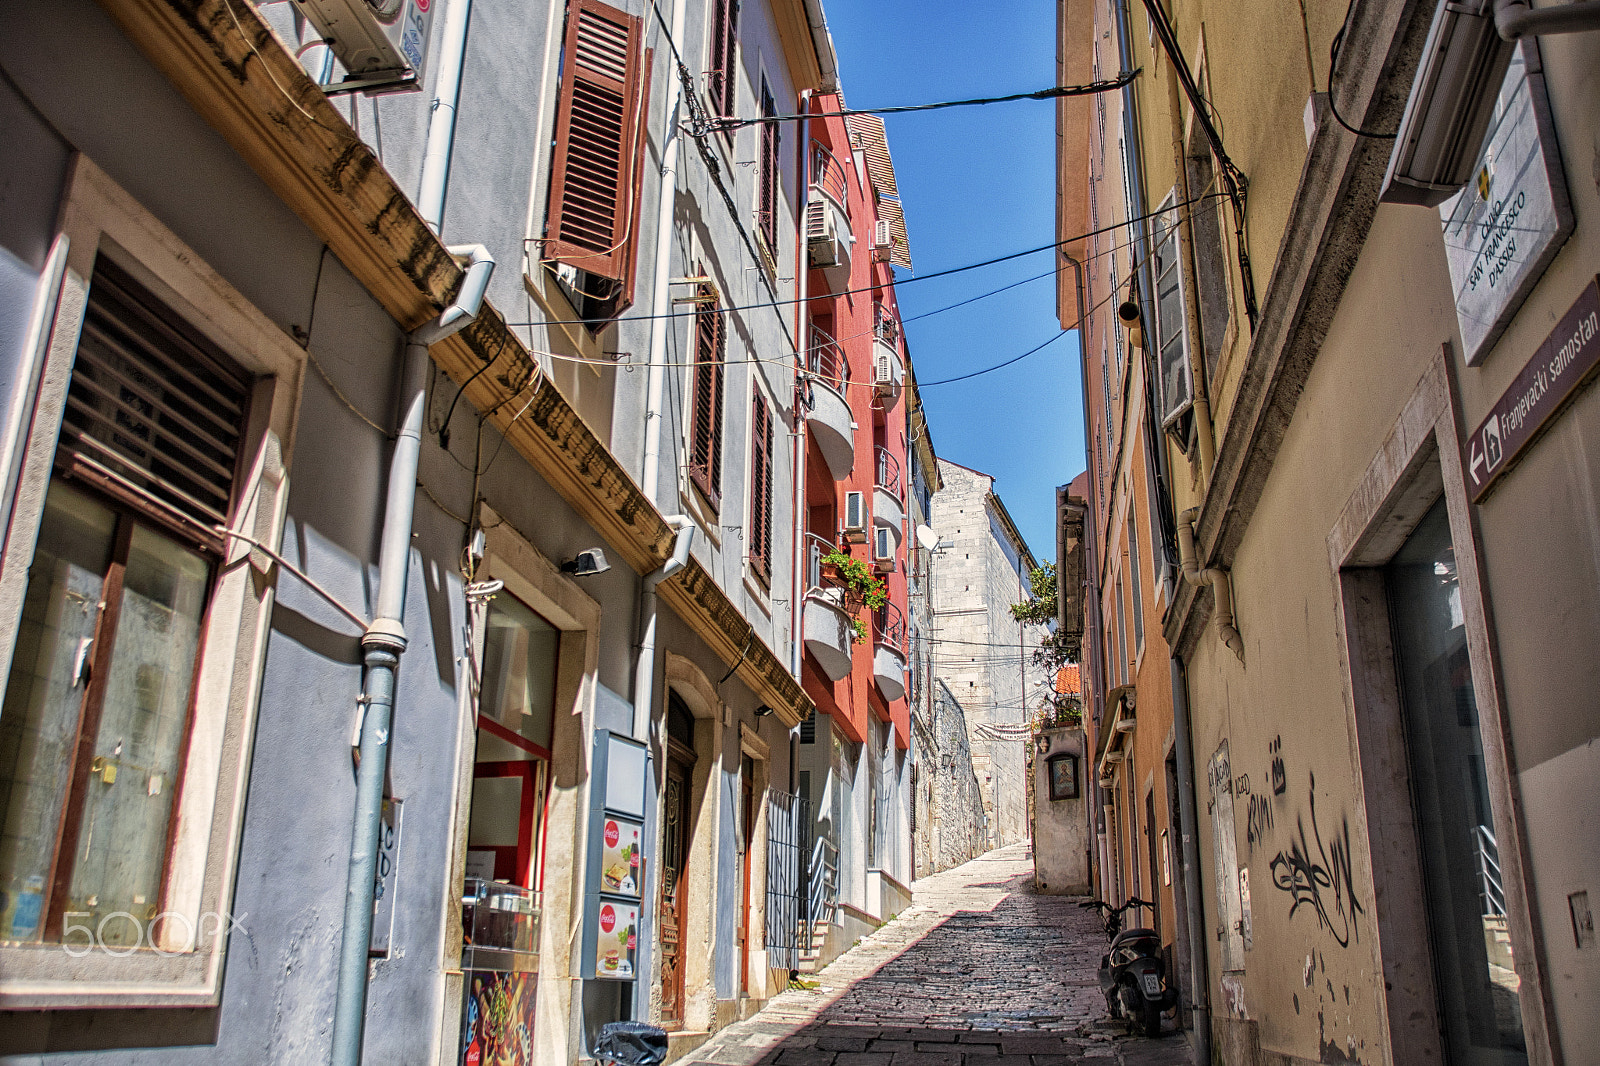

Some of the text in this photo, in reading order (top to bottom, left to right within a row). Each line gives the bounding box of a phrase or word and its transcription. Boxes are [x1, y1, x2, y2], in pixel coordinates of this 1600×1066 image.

[1469, 191, 1525, 291] SAN FRANCESCO
[1482, 200, 1501, 241] CLIVO
[1489, 237, 1517, 288] D'ASSISI
[1501, 311, 1599, 440] Franjevački samostan
